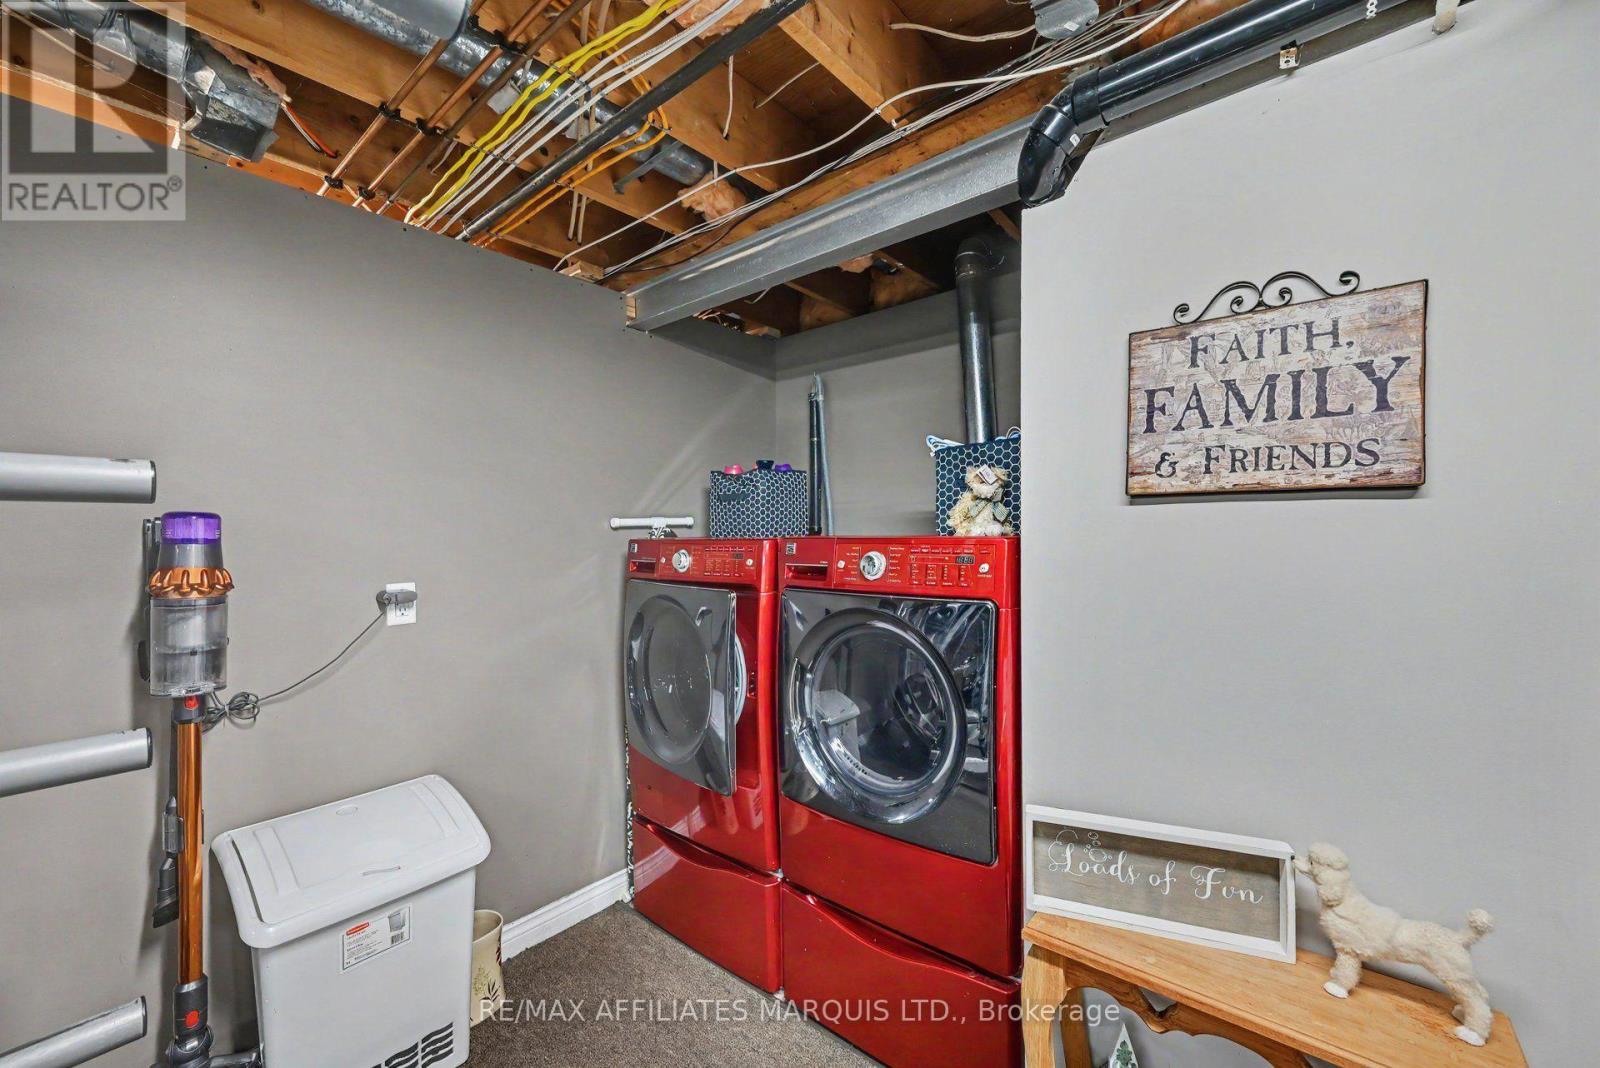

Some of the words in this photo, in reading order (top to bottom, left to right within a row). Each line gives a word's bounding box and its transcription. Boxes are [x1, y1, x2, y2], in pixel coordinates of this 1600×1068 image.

[1187, 318, 1355, 369] FAITH,
[1143, 356, 1411, 434] FAMILY
[1154, 451, 1179, 479] &
[1203, 438, 1381, 475] FRIENDS
[1047, 839, 1140, 886] Loads
[1148, 860, 1177, 895] of
[1190, 865, 1264, 905] Fun
